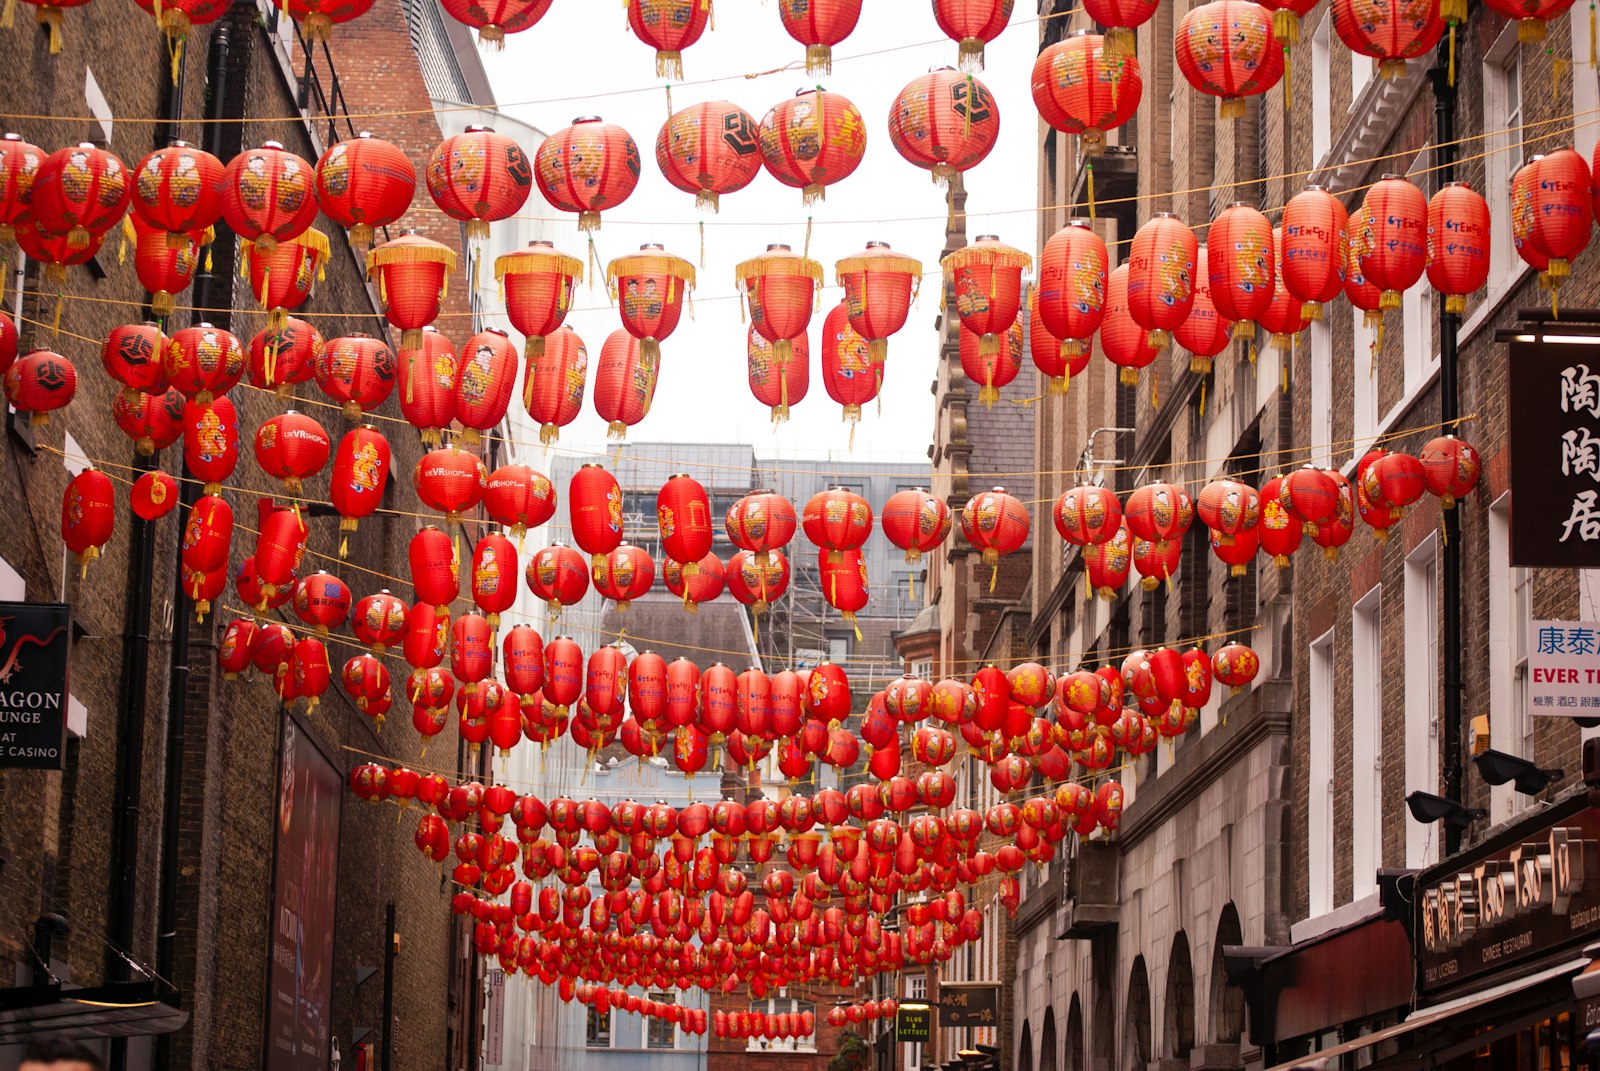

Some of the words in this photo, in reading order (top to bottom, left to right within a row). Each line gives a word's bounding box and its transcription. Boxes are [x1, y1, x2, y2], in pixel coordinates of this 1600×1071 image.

[1559, 363, 1600, 543] 陶陶居
[1537, 625, 1600, 655] 康泰
[1533, 668, 1579, 684] EVER
[1585, 668, 1600, 684] T
[1557, 696, 1578, 708] 酒店
[1, 732, 17, 743] AT
[8, 746, 58, 758] CASINO
[1482, 941, 1503, 963] CHINESE
[1503, 930, 1533, 955] RESTAURANT
[1438, 958, 1459, 979] LICENSED
[899, 1028, 928, 1036] LETTUCE
